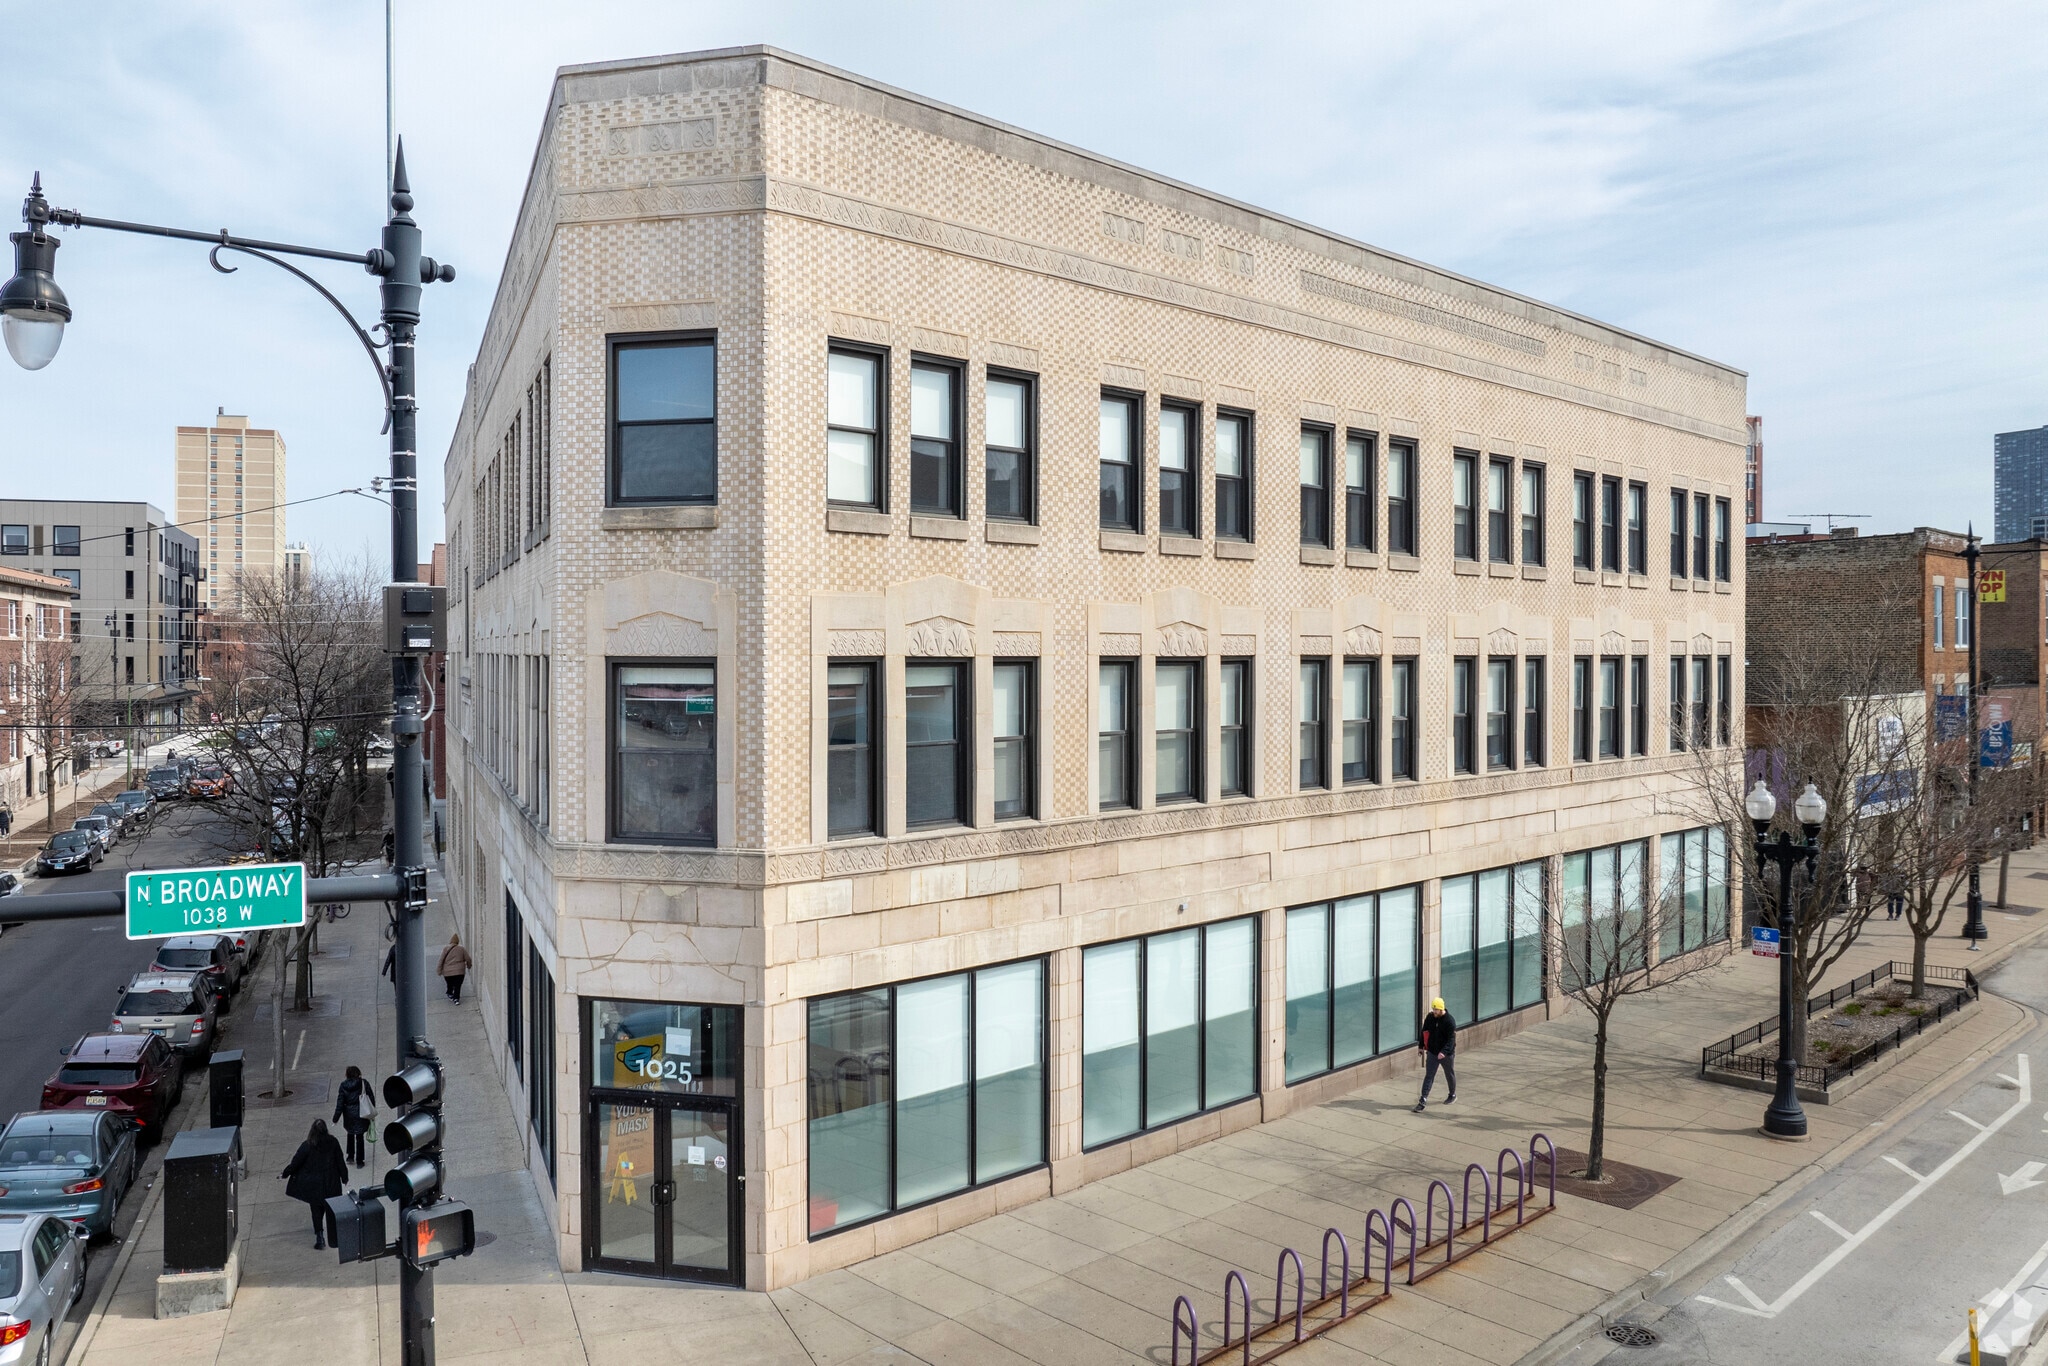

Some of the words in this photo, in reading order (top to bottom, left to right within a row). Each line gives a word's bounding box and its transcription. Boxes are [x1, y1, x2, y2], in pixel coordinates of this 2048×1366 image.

[1980, 570, 2003, 581] WN
[1980, 582, 2003, 593] OP
[137, 885, 150, 902] N
[161, 873, 294, 904] BROADWAY
[183, 906, 227, 925] 1038
[239, 904, 253, 921] W
[635, 1059, 692, 1085] 1025
[616, 1117, 649, 1136] MASK
